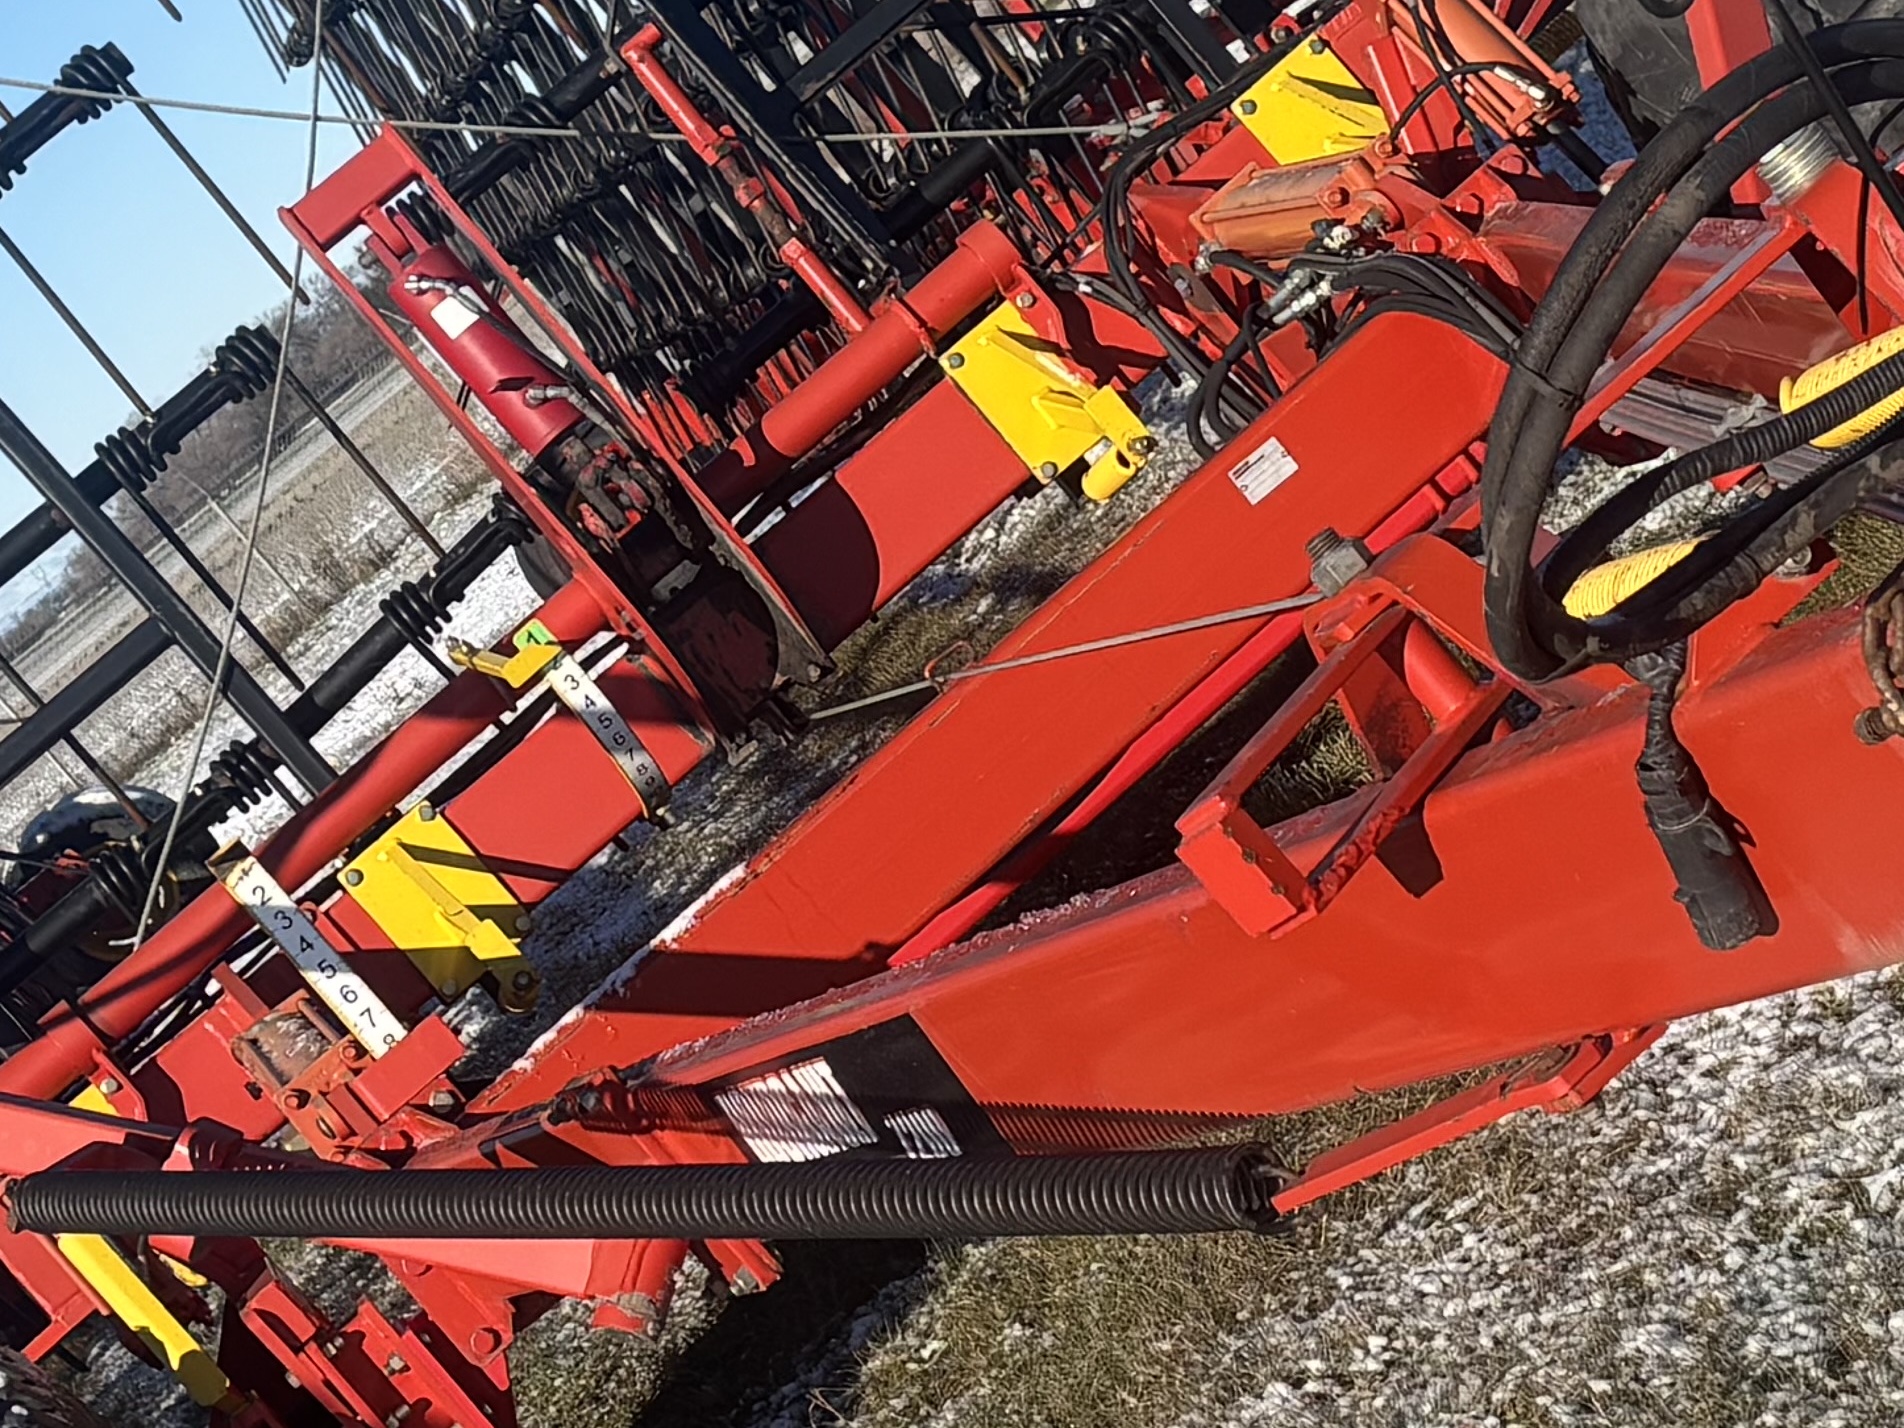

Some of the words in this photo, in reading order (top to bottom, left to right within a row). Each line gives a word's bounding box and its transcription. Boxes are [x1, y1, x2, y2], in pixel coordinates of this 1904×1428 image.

[563, 673, 580, 690] 3
[584, 693, 597, 710] 4
[597, 712, 613, 729] 5
[612, 730, 626, 746] 6
[624, 747, 634, 762] 7
[636, 762, 649, 776] 8
[252, 884, 273, 907] 2
[274, 909, 293, 931] 3
[298, 934, 315, 954] 4
[316, 958, 338, 980] 5
[339, 984, 359, 1004] 6
[359, 1006, 377, 1028] 7
